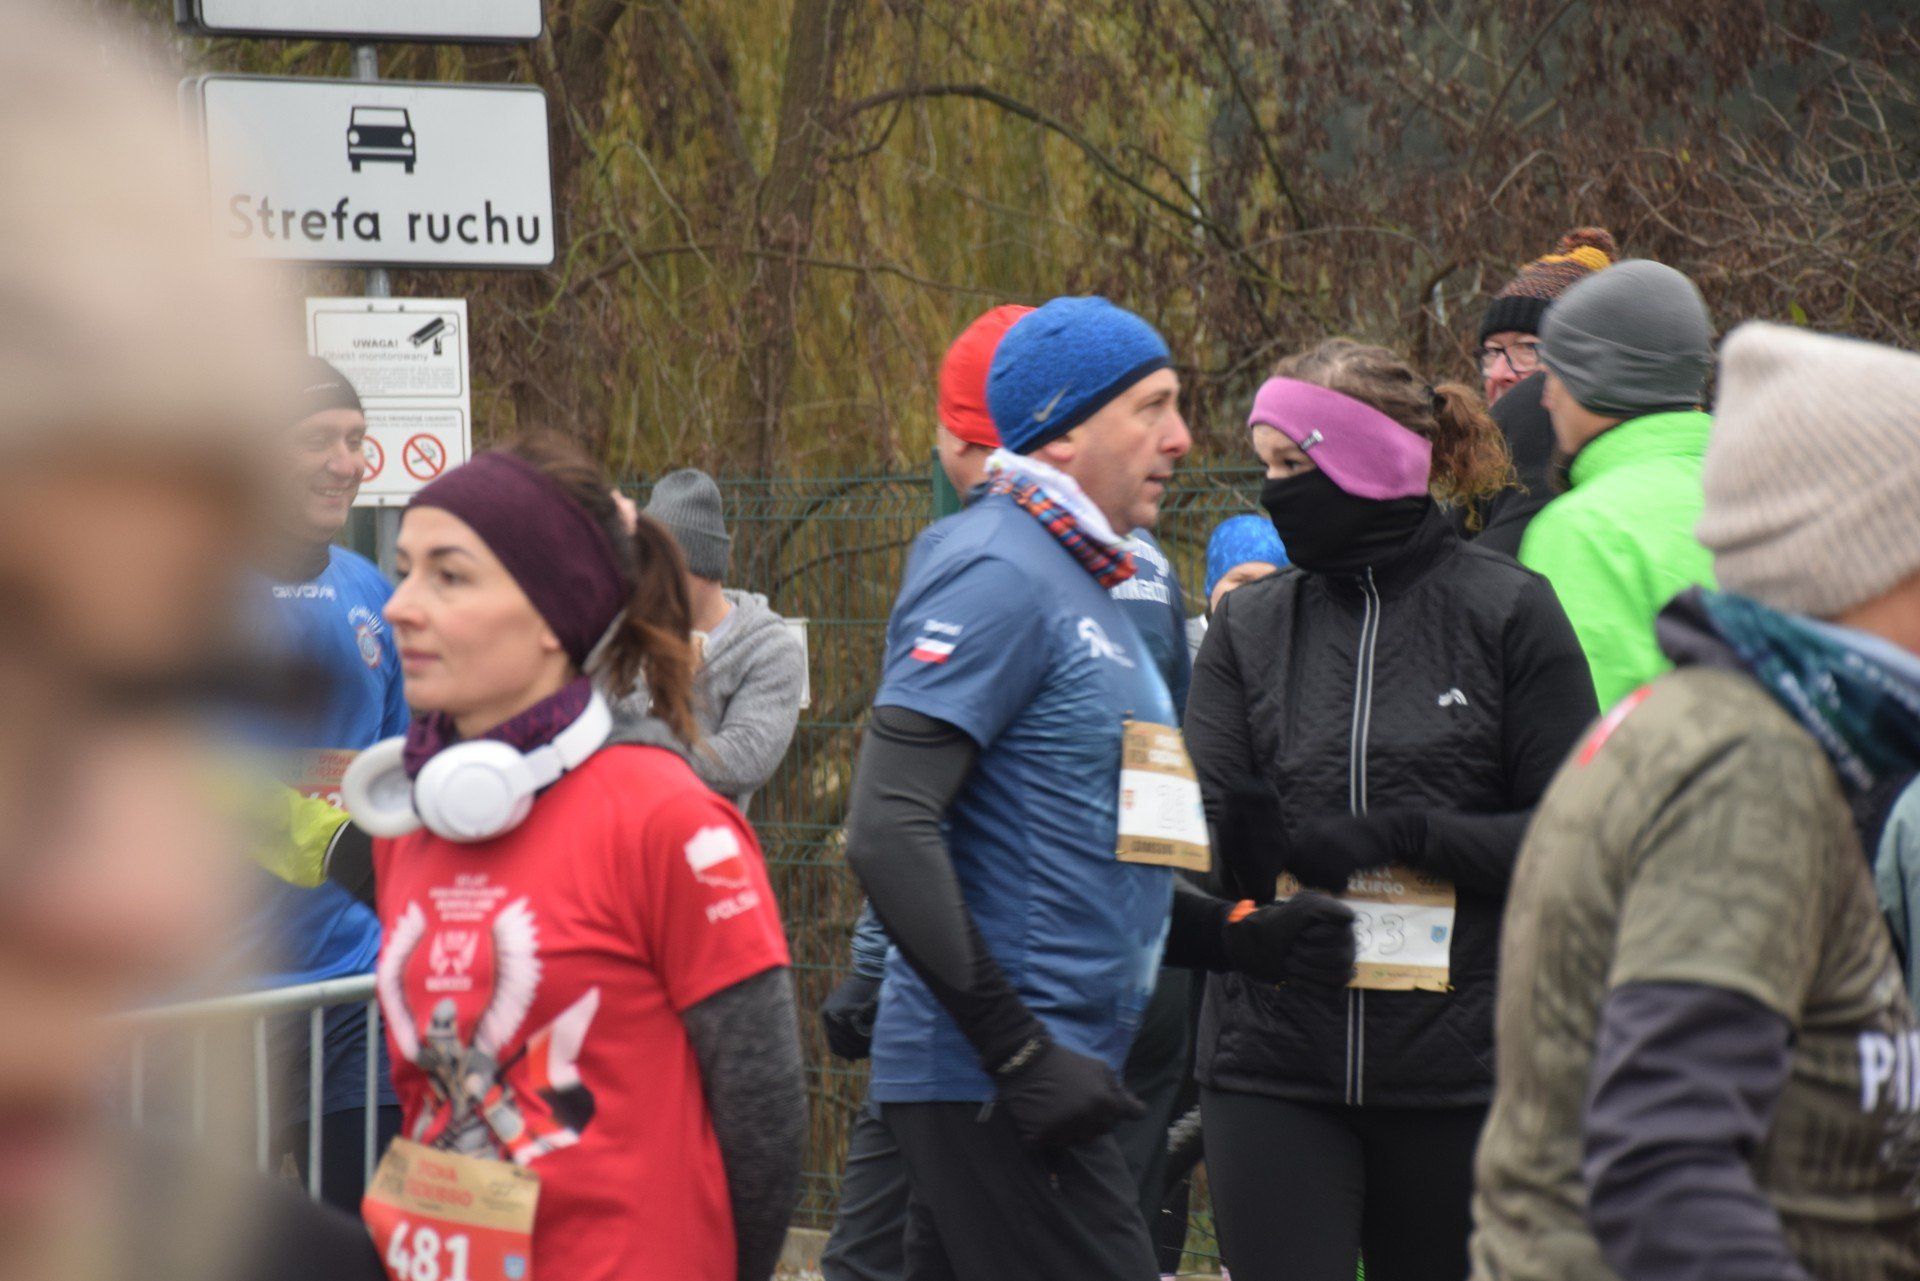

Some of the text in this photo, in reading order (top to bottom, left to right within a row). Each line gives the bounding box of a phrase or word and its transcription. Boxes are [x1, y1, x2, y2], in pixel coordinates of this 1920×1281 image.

[228, 194, 541, 245] Strefa ruchu
[353, 338, 399, 349] UWAGA!
[358, 351, 429, 363] monitorowany
[386, 1221, 470, 1281] 481
